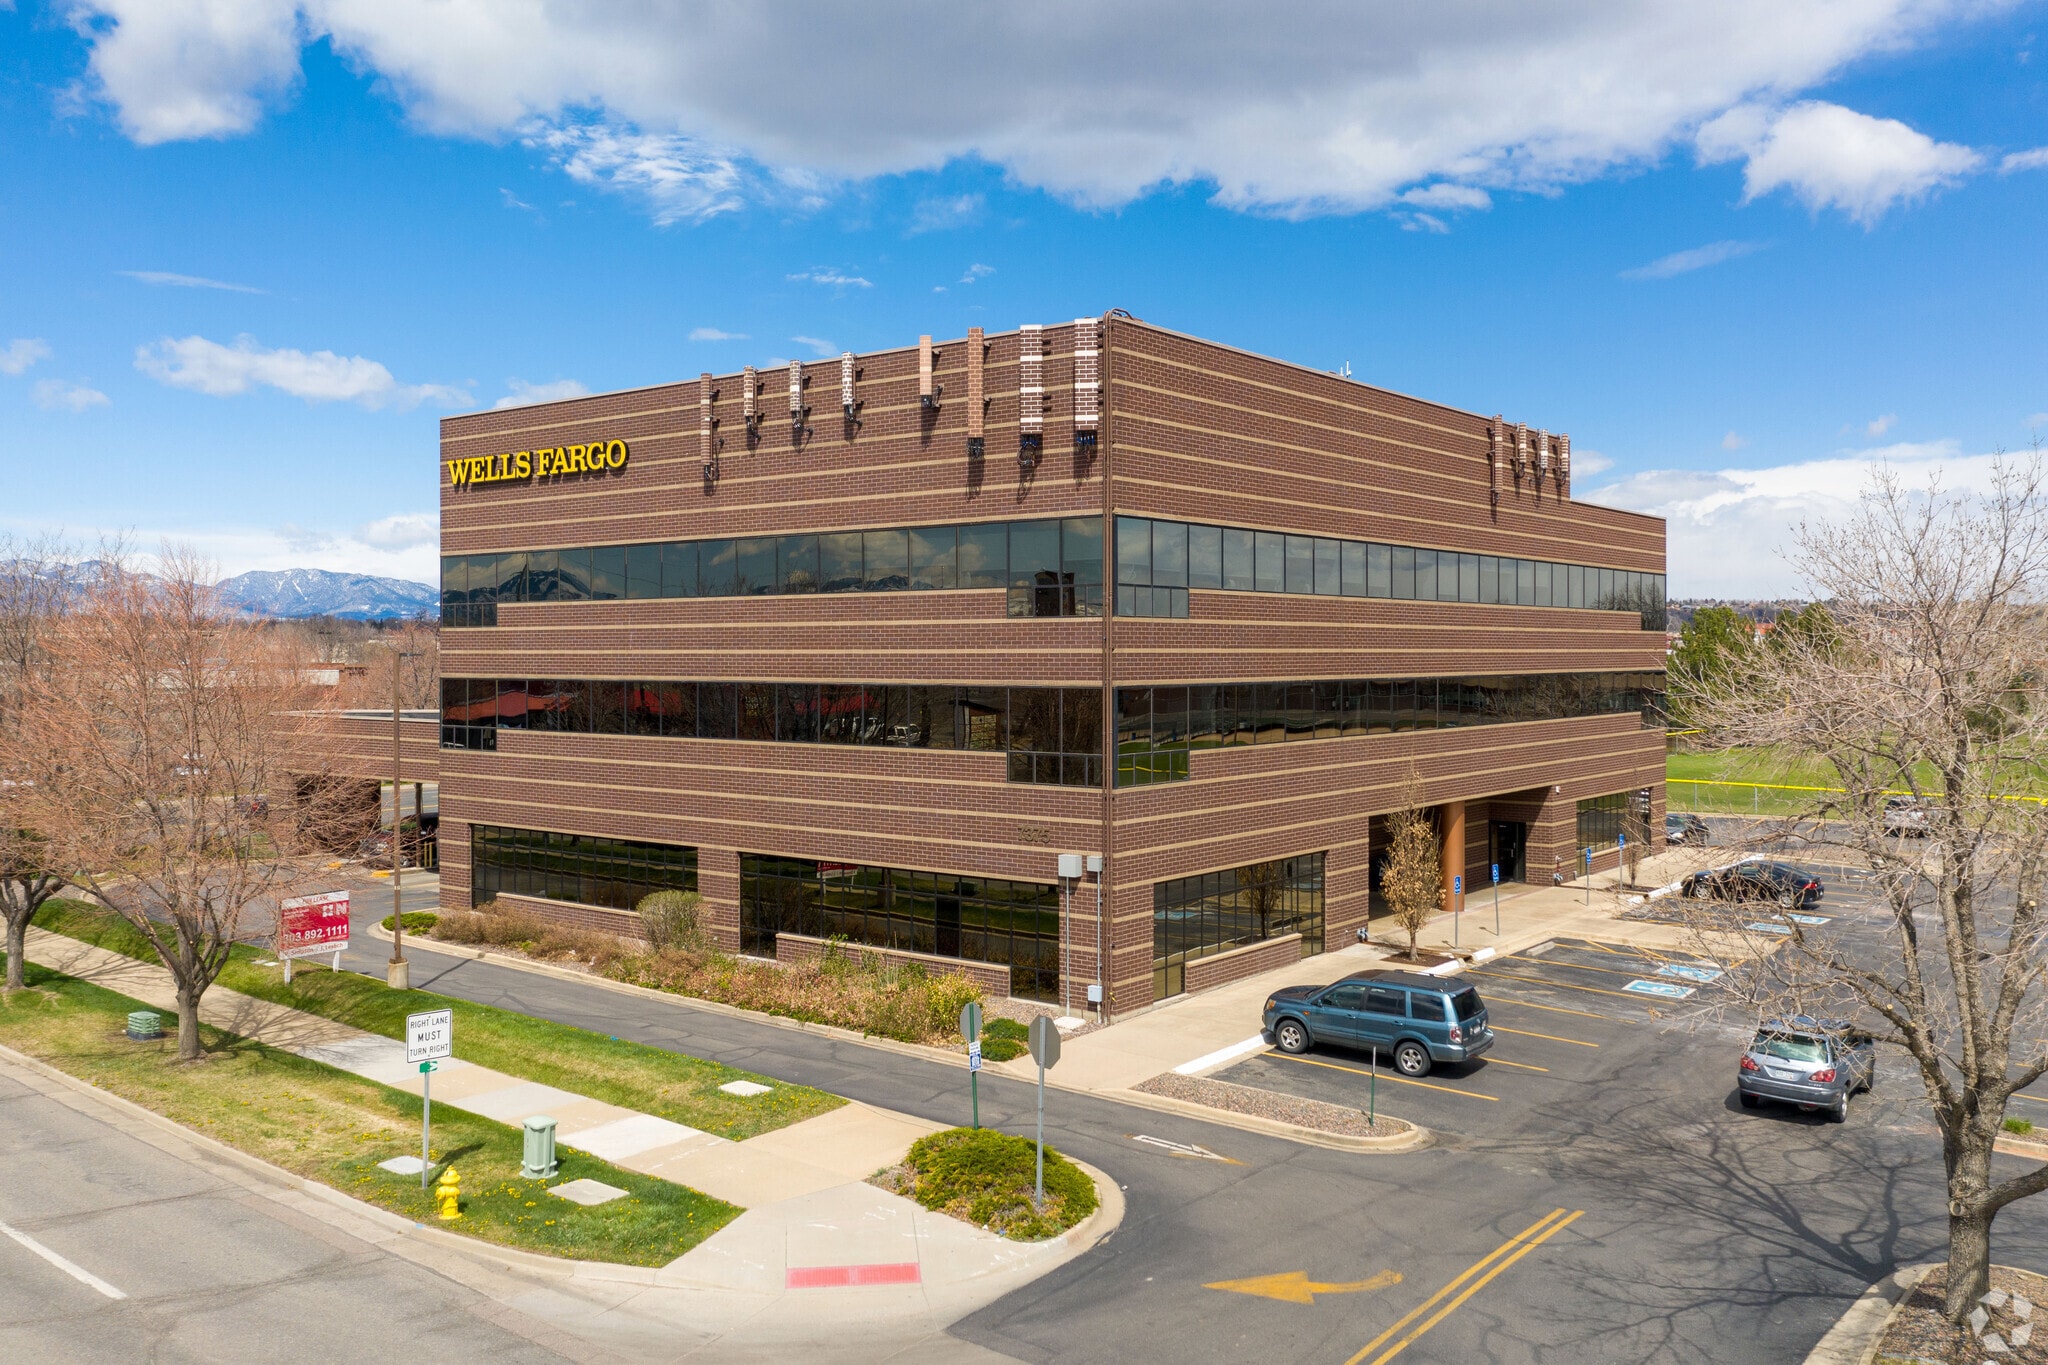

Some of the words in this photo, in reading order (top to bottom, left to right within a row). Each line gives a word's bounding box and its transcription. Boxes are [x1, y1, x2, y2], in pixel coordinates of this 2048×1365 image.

[447, 451, 531, 485] WELLS
[536, 439, 627, 476] FARGO
[1017, 824, 1051, 844] 7375
[410, 1018, 430, 1029] RIGHT
[431, 1016, 449, 1026] LANE
[417, 1030, 441, 1043] MUST
[410, 1047, 427, 1057] TURN
[429, 1043, 449, 1053] RIGHT
